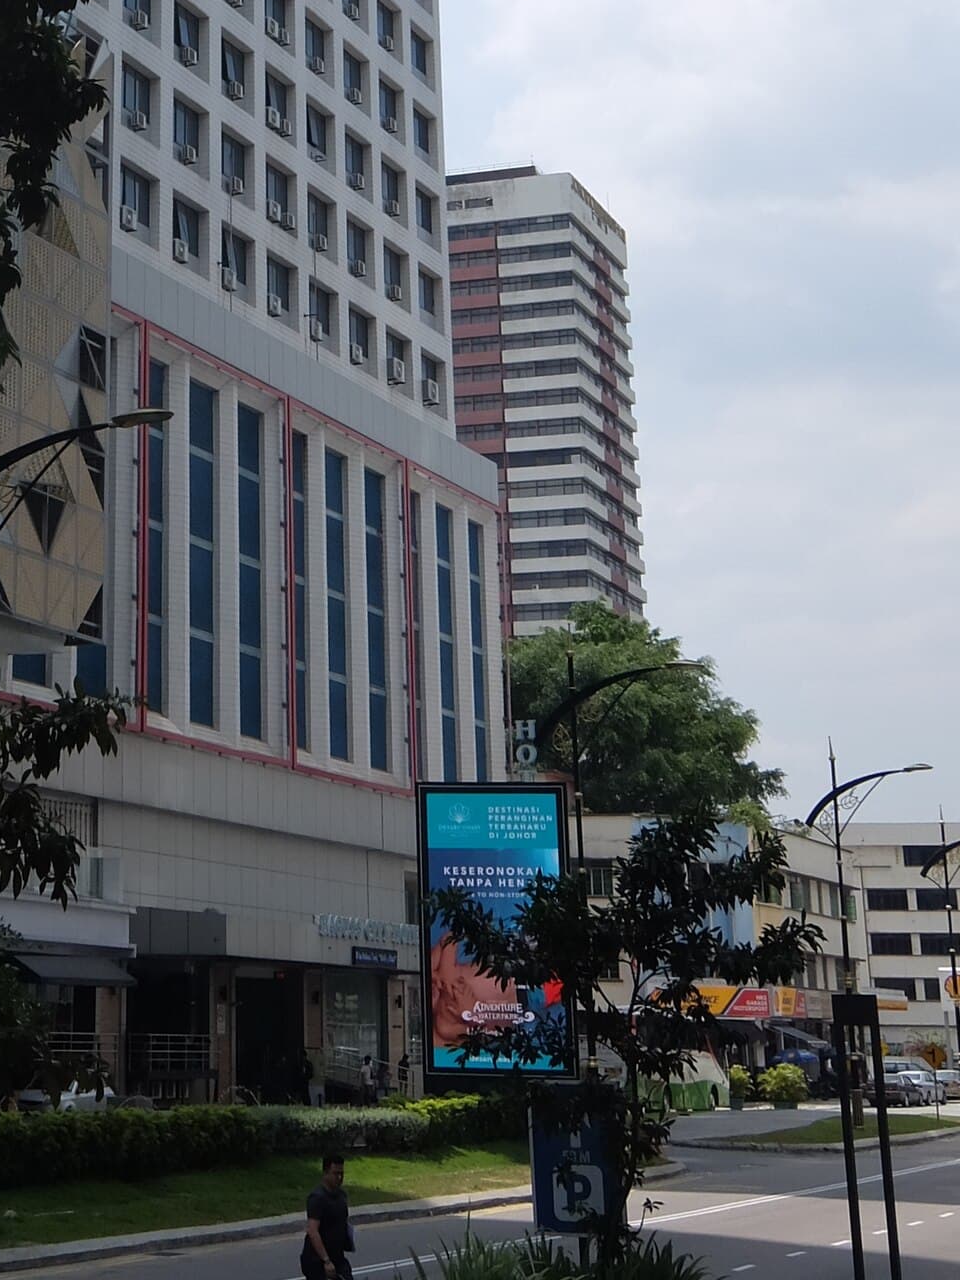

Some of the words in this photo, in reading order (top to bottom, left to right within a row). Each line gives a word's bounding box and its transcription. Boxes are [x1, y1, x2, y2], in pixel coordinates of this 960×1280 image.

[488, 806, 540, 814] DESTINASI
[488, 823, 547, 831] TERBAHARU
[449, 877, 493, 888] TANPA
